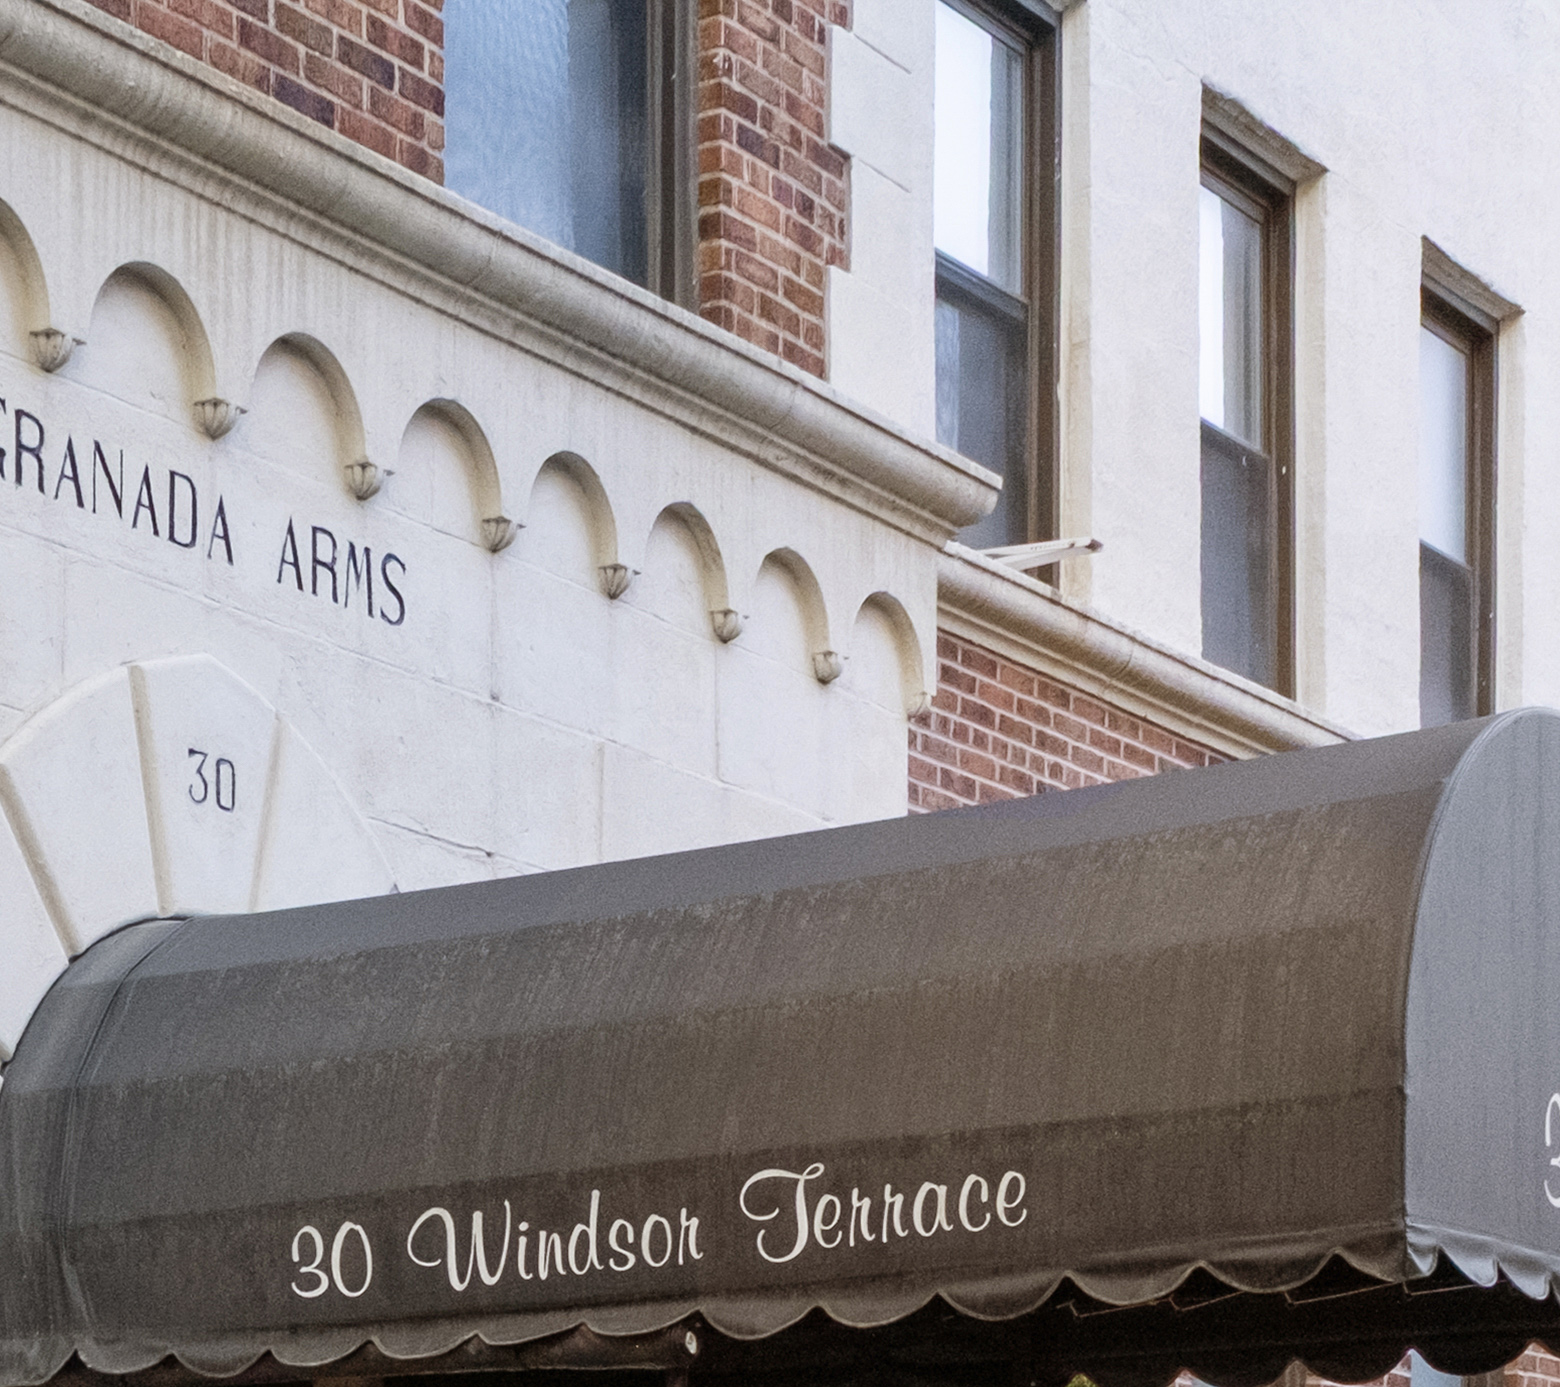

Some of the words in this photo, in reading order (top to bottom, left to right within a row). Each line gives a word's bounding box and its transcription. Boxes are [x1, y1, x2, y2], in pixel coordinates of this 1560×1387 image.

[275, 516, 408, 627] ARMS
[186, 746, 237, 813] 30
[290, 1221, 374, 1298] 30
[406, 1189, 705, 1292] Windsor
[738, 1162, 1028, 1264] Terrace
